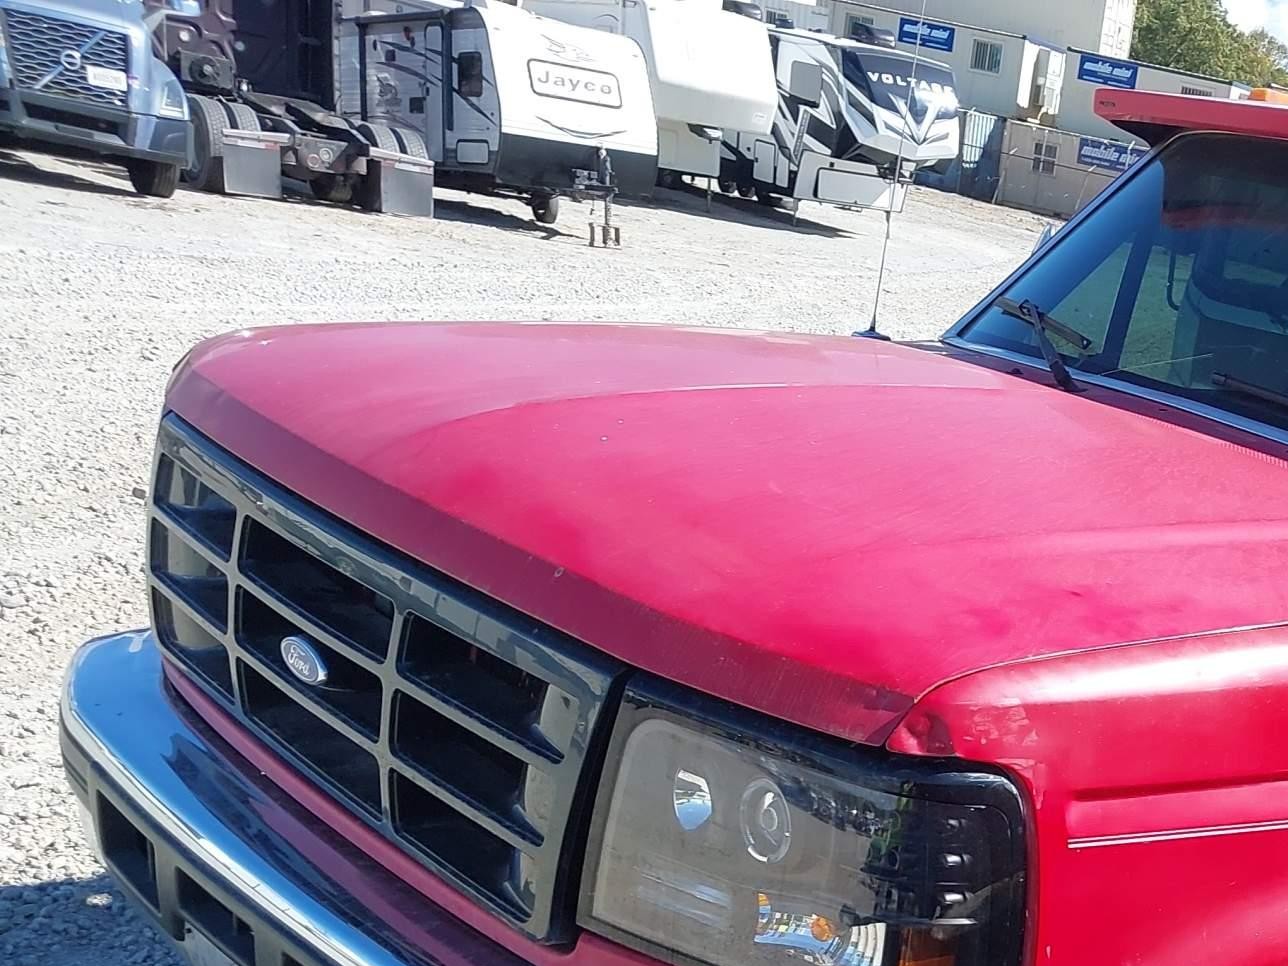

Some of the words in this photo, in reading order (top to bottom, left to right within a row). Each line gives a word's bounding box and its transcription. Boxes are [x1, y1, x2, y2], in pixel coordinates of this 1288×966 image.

[537, 70, 613, 95] Jayco
[1081, 145, 1120, 161] mobile
[286, 644, 311, 676] Ford
